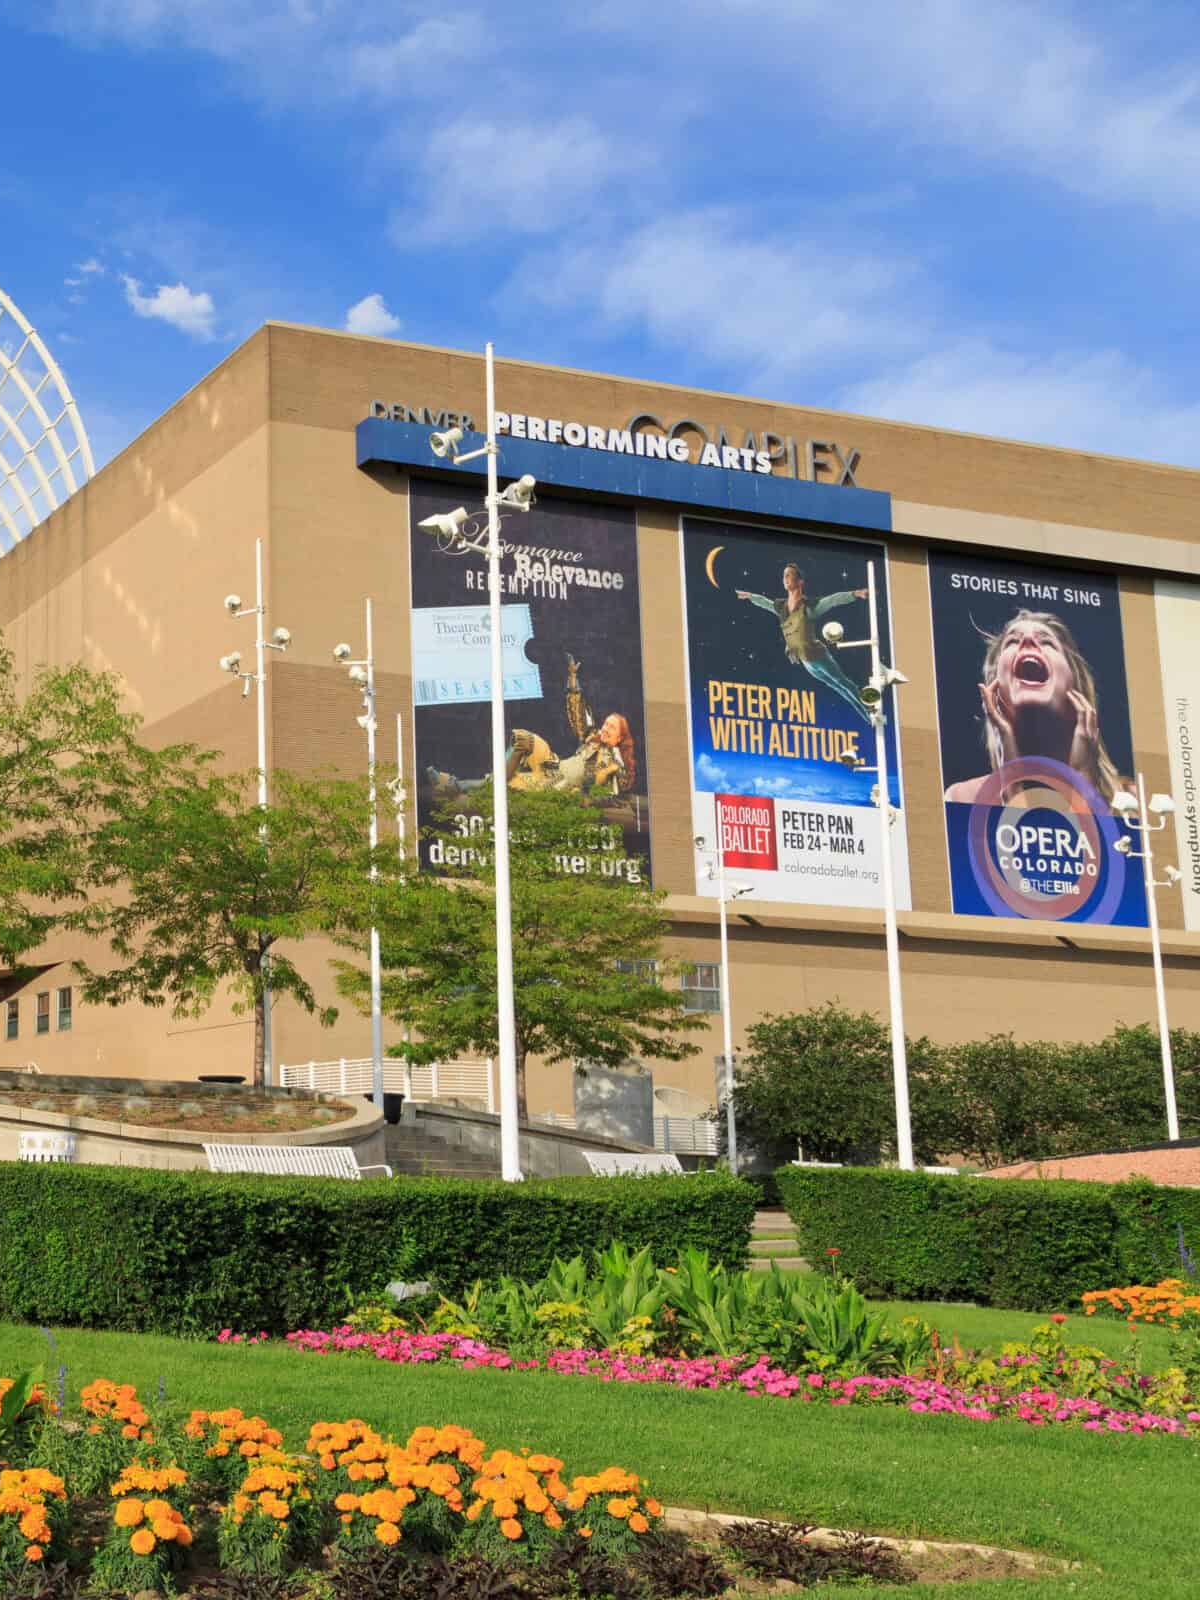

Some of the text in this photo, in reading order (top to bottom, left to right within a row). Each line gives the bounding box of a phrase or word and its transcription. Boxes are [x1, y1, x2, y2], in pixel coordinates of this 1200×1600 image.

[370, 400, 475, 432] DENVER
[495, 412, 690, 462] PERFORMING
[701, 442, 772, 474] ARTS
[466, 569, 568, 600] REEMPTION
[514, 553, 624, 590] Relevance
[951, 573, 1101, 606] STORIES THAT SING
[434, 621, 480, 635] Theatre
[462, 632, 516, 647] Comny
[708, 680, 816, 725] PETER PAN
[1176, 697, 1188, 723] the
[709, 717, 865, 765] WITH ALTITUDE.
[1178, 725, 1194, 802] colorado
[721, 804, 770, 826] COLORADO
[782, 810, 854, 835] PETER PAN
[723, 825, 771, 855] BALLET
[783, 832, 804, 850] FEB
[808, 835, 821, 851] 24
[830, 838, 854, 854] MAR
[857, 840, 865, 855] 4
[995, 824, 1097, 859] OPERA
[784, 863, 880, 884] coloradoballet.org
[999, 855, 1098, 877] COLORADO
